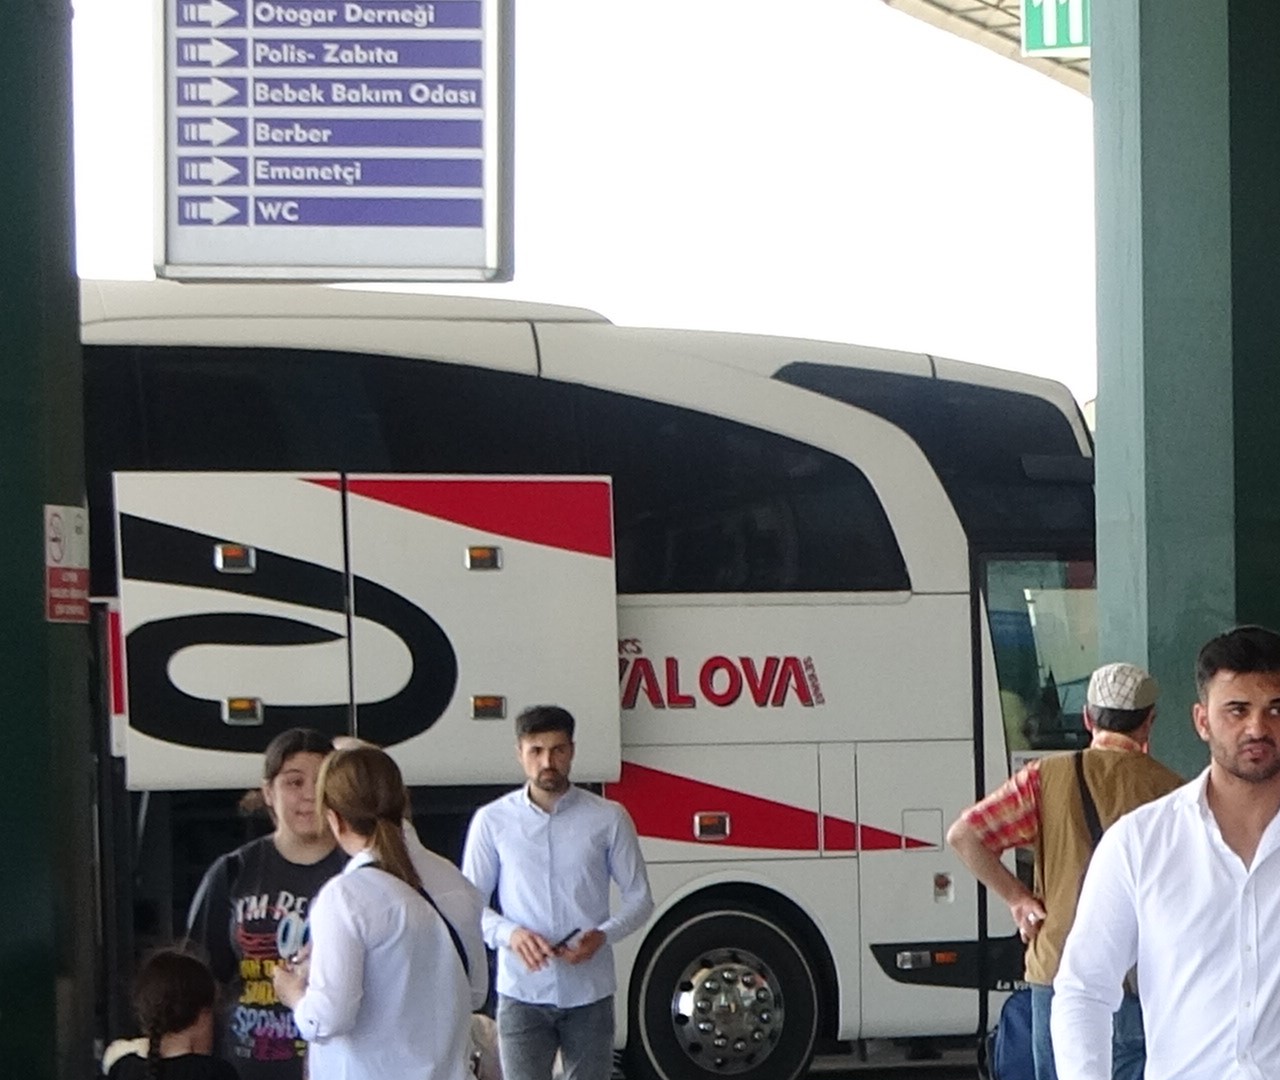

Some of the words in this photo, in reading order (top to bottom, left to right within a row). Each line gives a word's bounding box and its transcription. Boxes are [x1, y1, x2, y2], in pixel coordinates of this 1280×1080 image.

[254, 2, 337, 26] Otogar
[345, 2, 435, 27] Derneği
[1030, 0, 1083, 47] 11
[255, 43, 316, 63] Polis-
[322, 43, 399, 63] Zabıta
[255, 83, 325, 103] Bebek
[331, 83, 403, 103] Bakım
[409, 82, 477, 104] Odası
[255, 123, 333, 143] Berber
[255, 161, 362, 185] Emanetçi
[257, 202, 300, 222] WC
